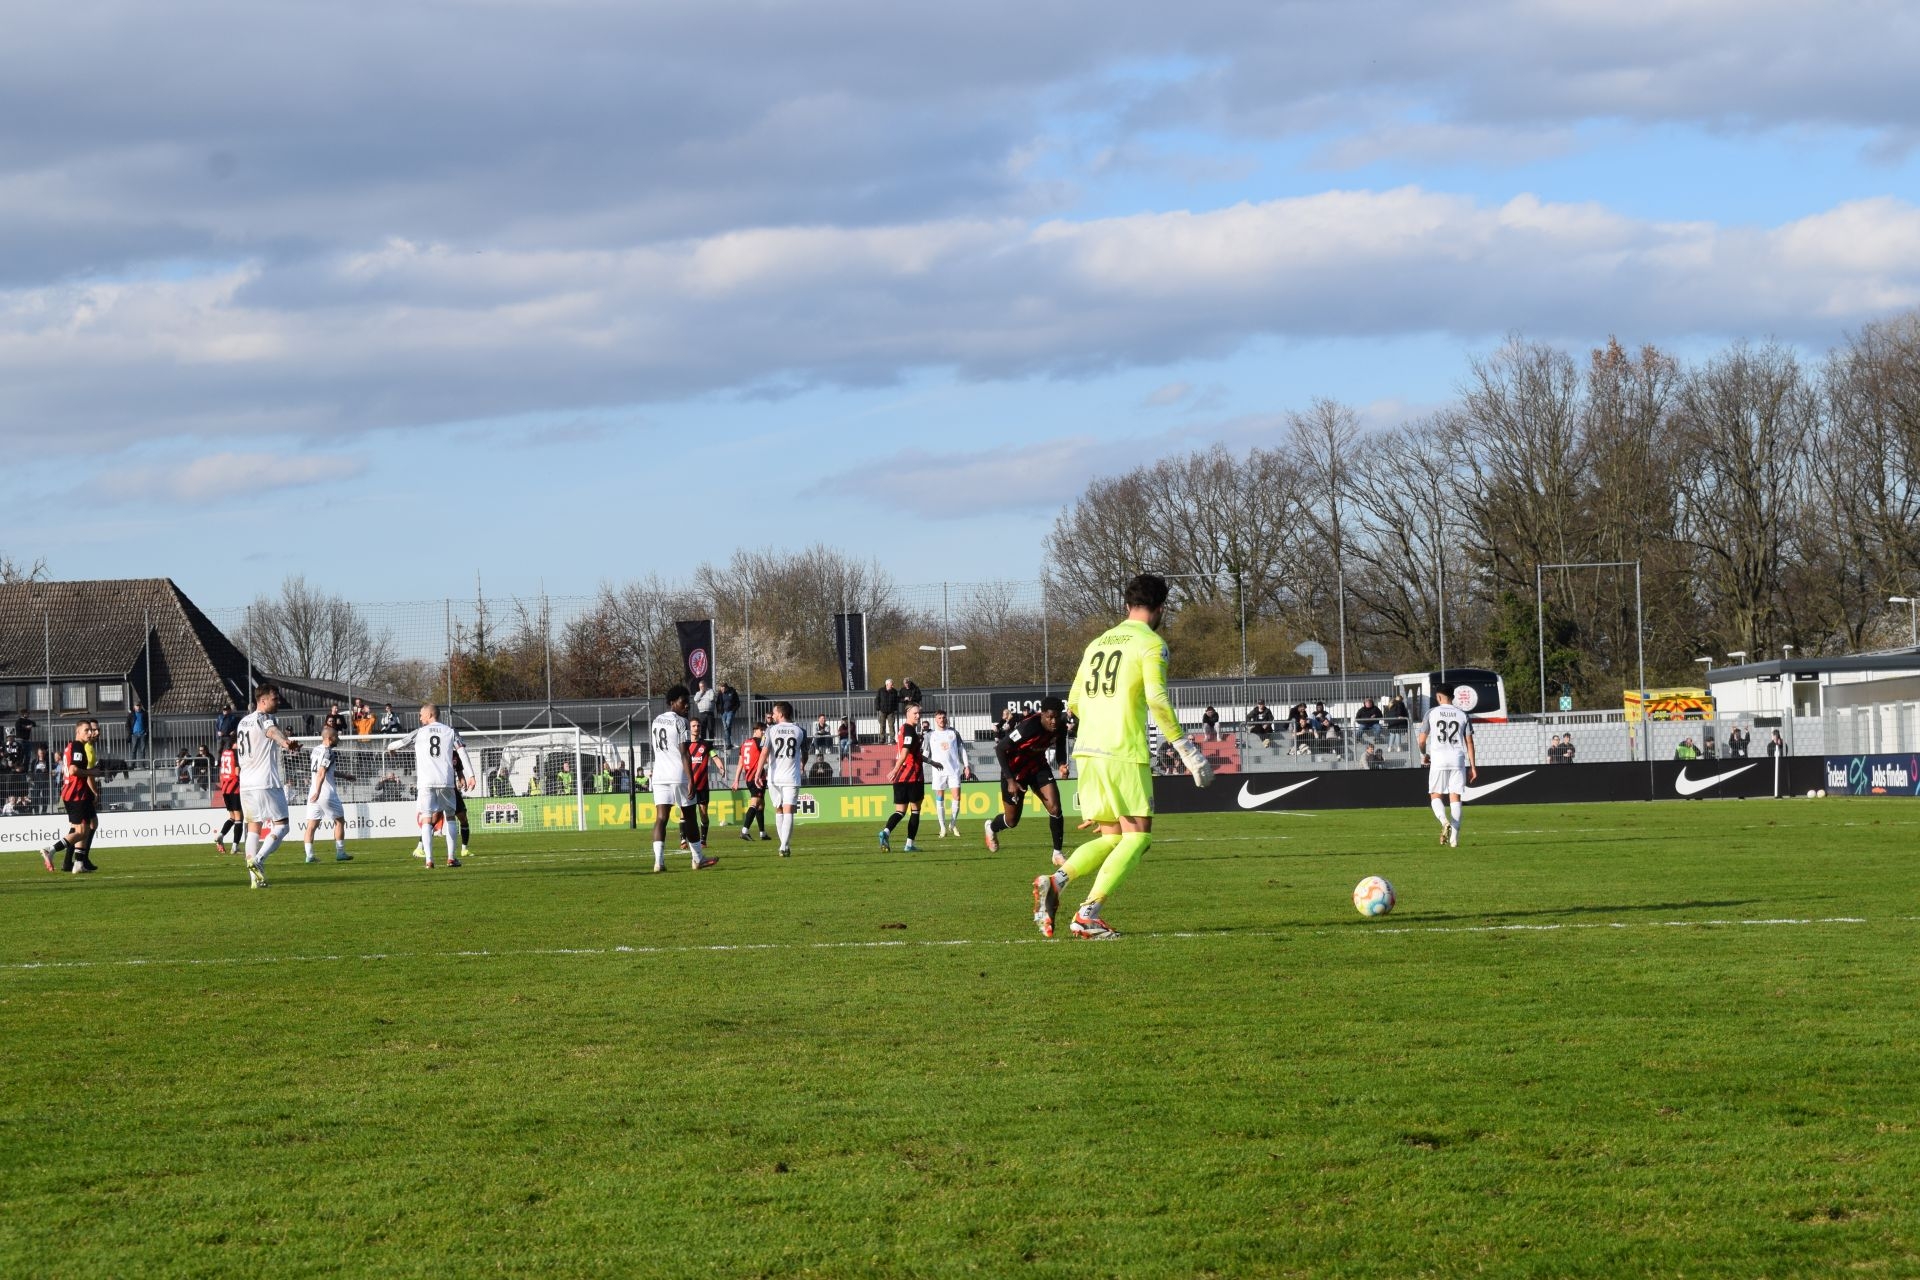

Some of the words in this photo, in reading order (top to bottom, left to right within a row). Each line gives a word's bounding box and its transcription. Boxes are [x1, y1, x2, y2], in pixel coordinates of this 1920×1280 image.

[1085, 650, 1122, 697] 39
[1008, 700, 1042, 714] BLOC
[237, 730, 252, 757] 31
[653, 727, 669, 751] 18
[1437, 720, 1460, 744] 32
[429, 735, 441, 758] 8
[743, 747, 750, 765] 5
[775, 737, 797, 759] 28
[1826, 761, 1848, 787] indeed
[1871, 764, 1886, 787] Jobs
[1886, 762, 1908, 787] finden
[485, 809, 519, 824] FFH
[543, 804, 589, 827] HIT
[598, 802, 684, 825] RADO
[841, 795, 887, 817] HIT
[133, 828, 158, 838] von
